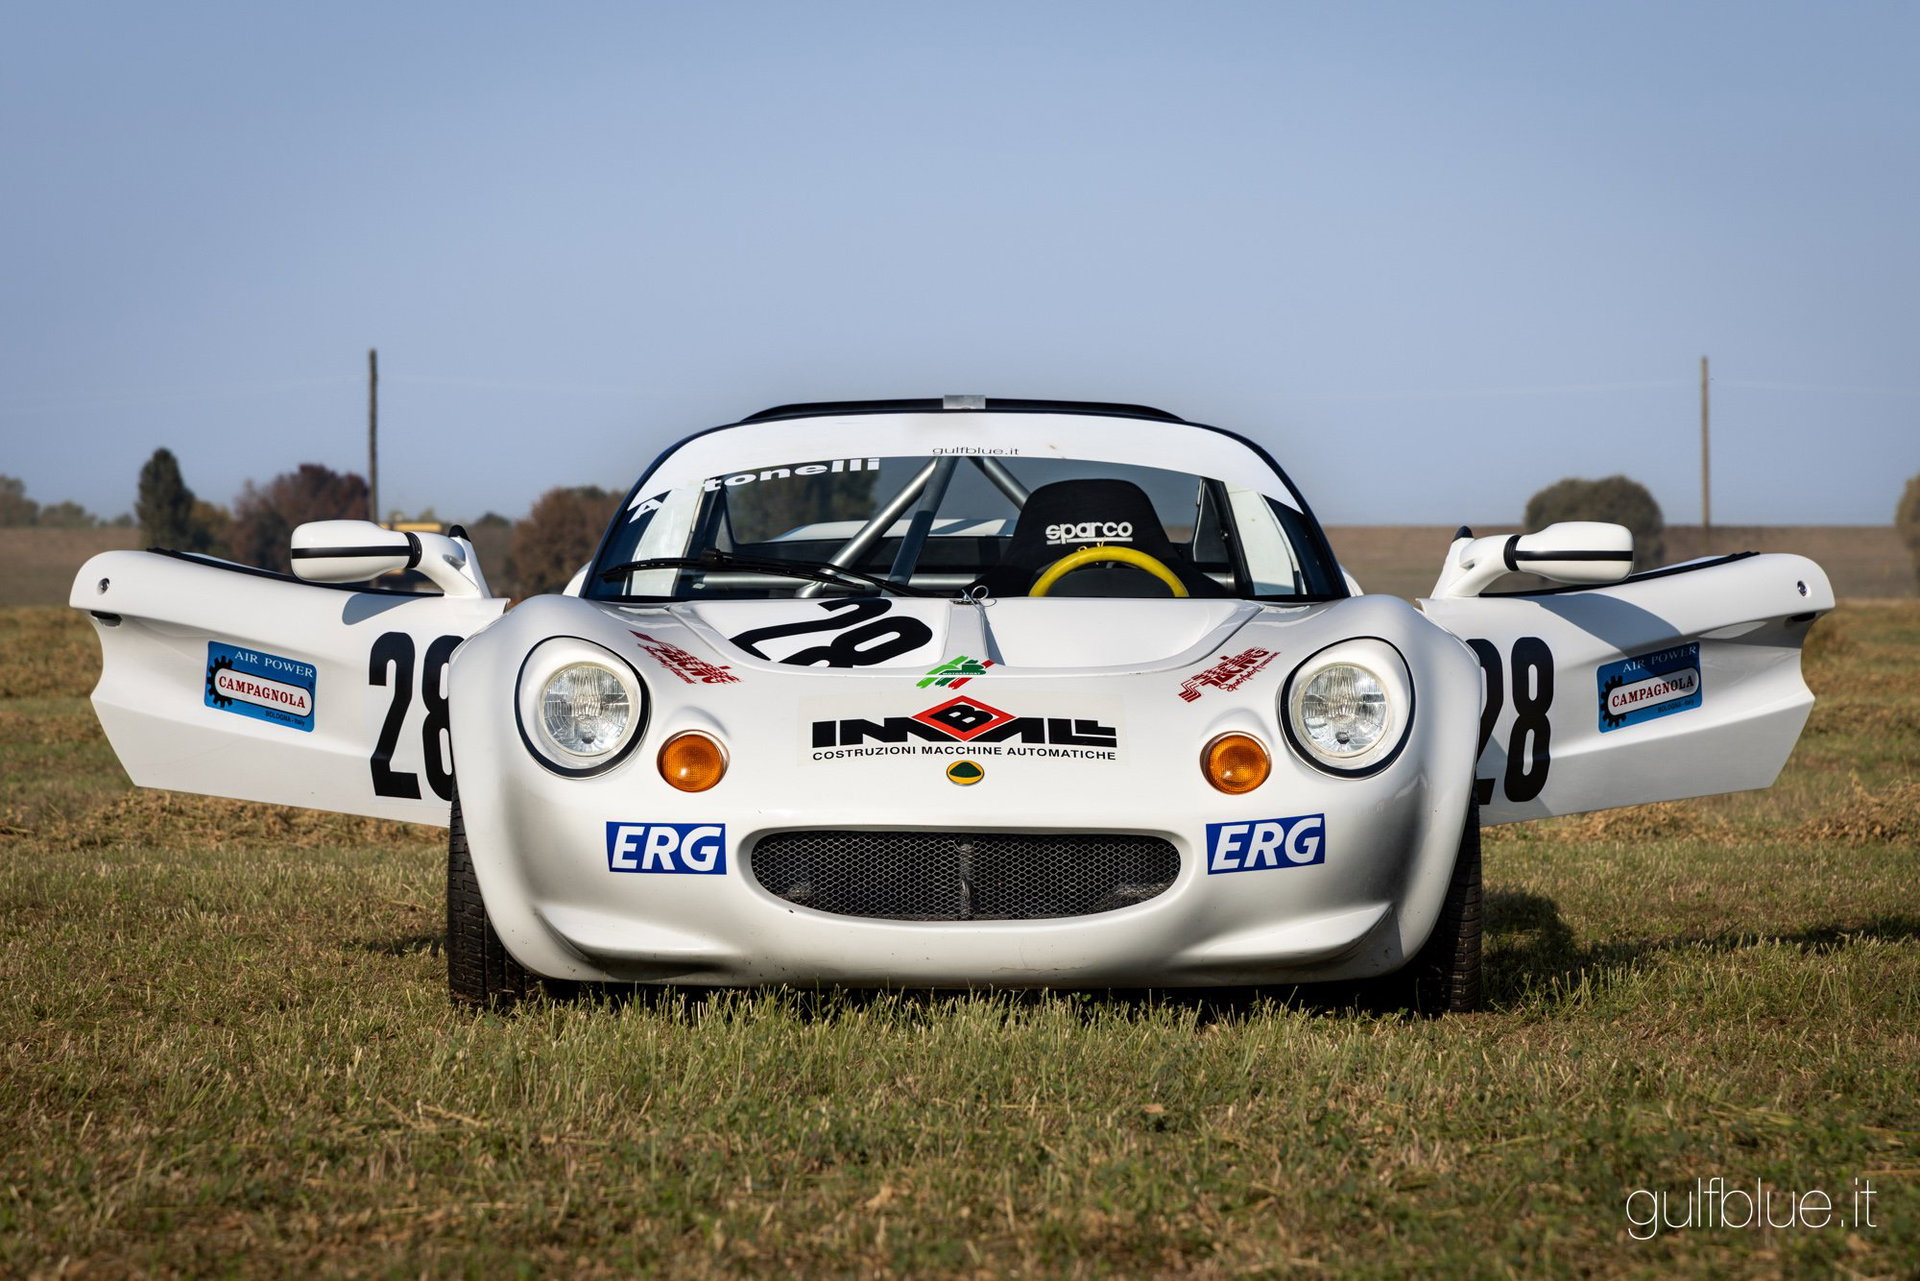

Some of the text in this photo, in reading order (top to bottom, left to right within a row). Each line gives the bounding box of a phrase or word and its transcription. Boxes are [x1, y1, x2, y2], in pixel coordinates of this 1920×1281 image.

[932, 446, 1019, 455] gulfblue.it
[1045, 521, 1133, 544] sparco
[234, 651, 313, 678] AIR POWER
[1623, 646, 1696, 673] AIR POWER
[218, 676, 306, 708] CAMPAGNOLA
[1612, 675, 1694, 708] CAMPAGNOLA
[369, 632, 465, 801] 28
[1465, 636, 1554, 802] 28
[812, 746, 1117, 761] COSTRUZIONI MACCHINE AUTOMATICHE
[611, 825, 722, 872] ERG
[1210, 817, 1322, 871] ERG
